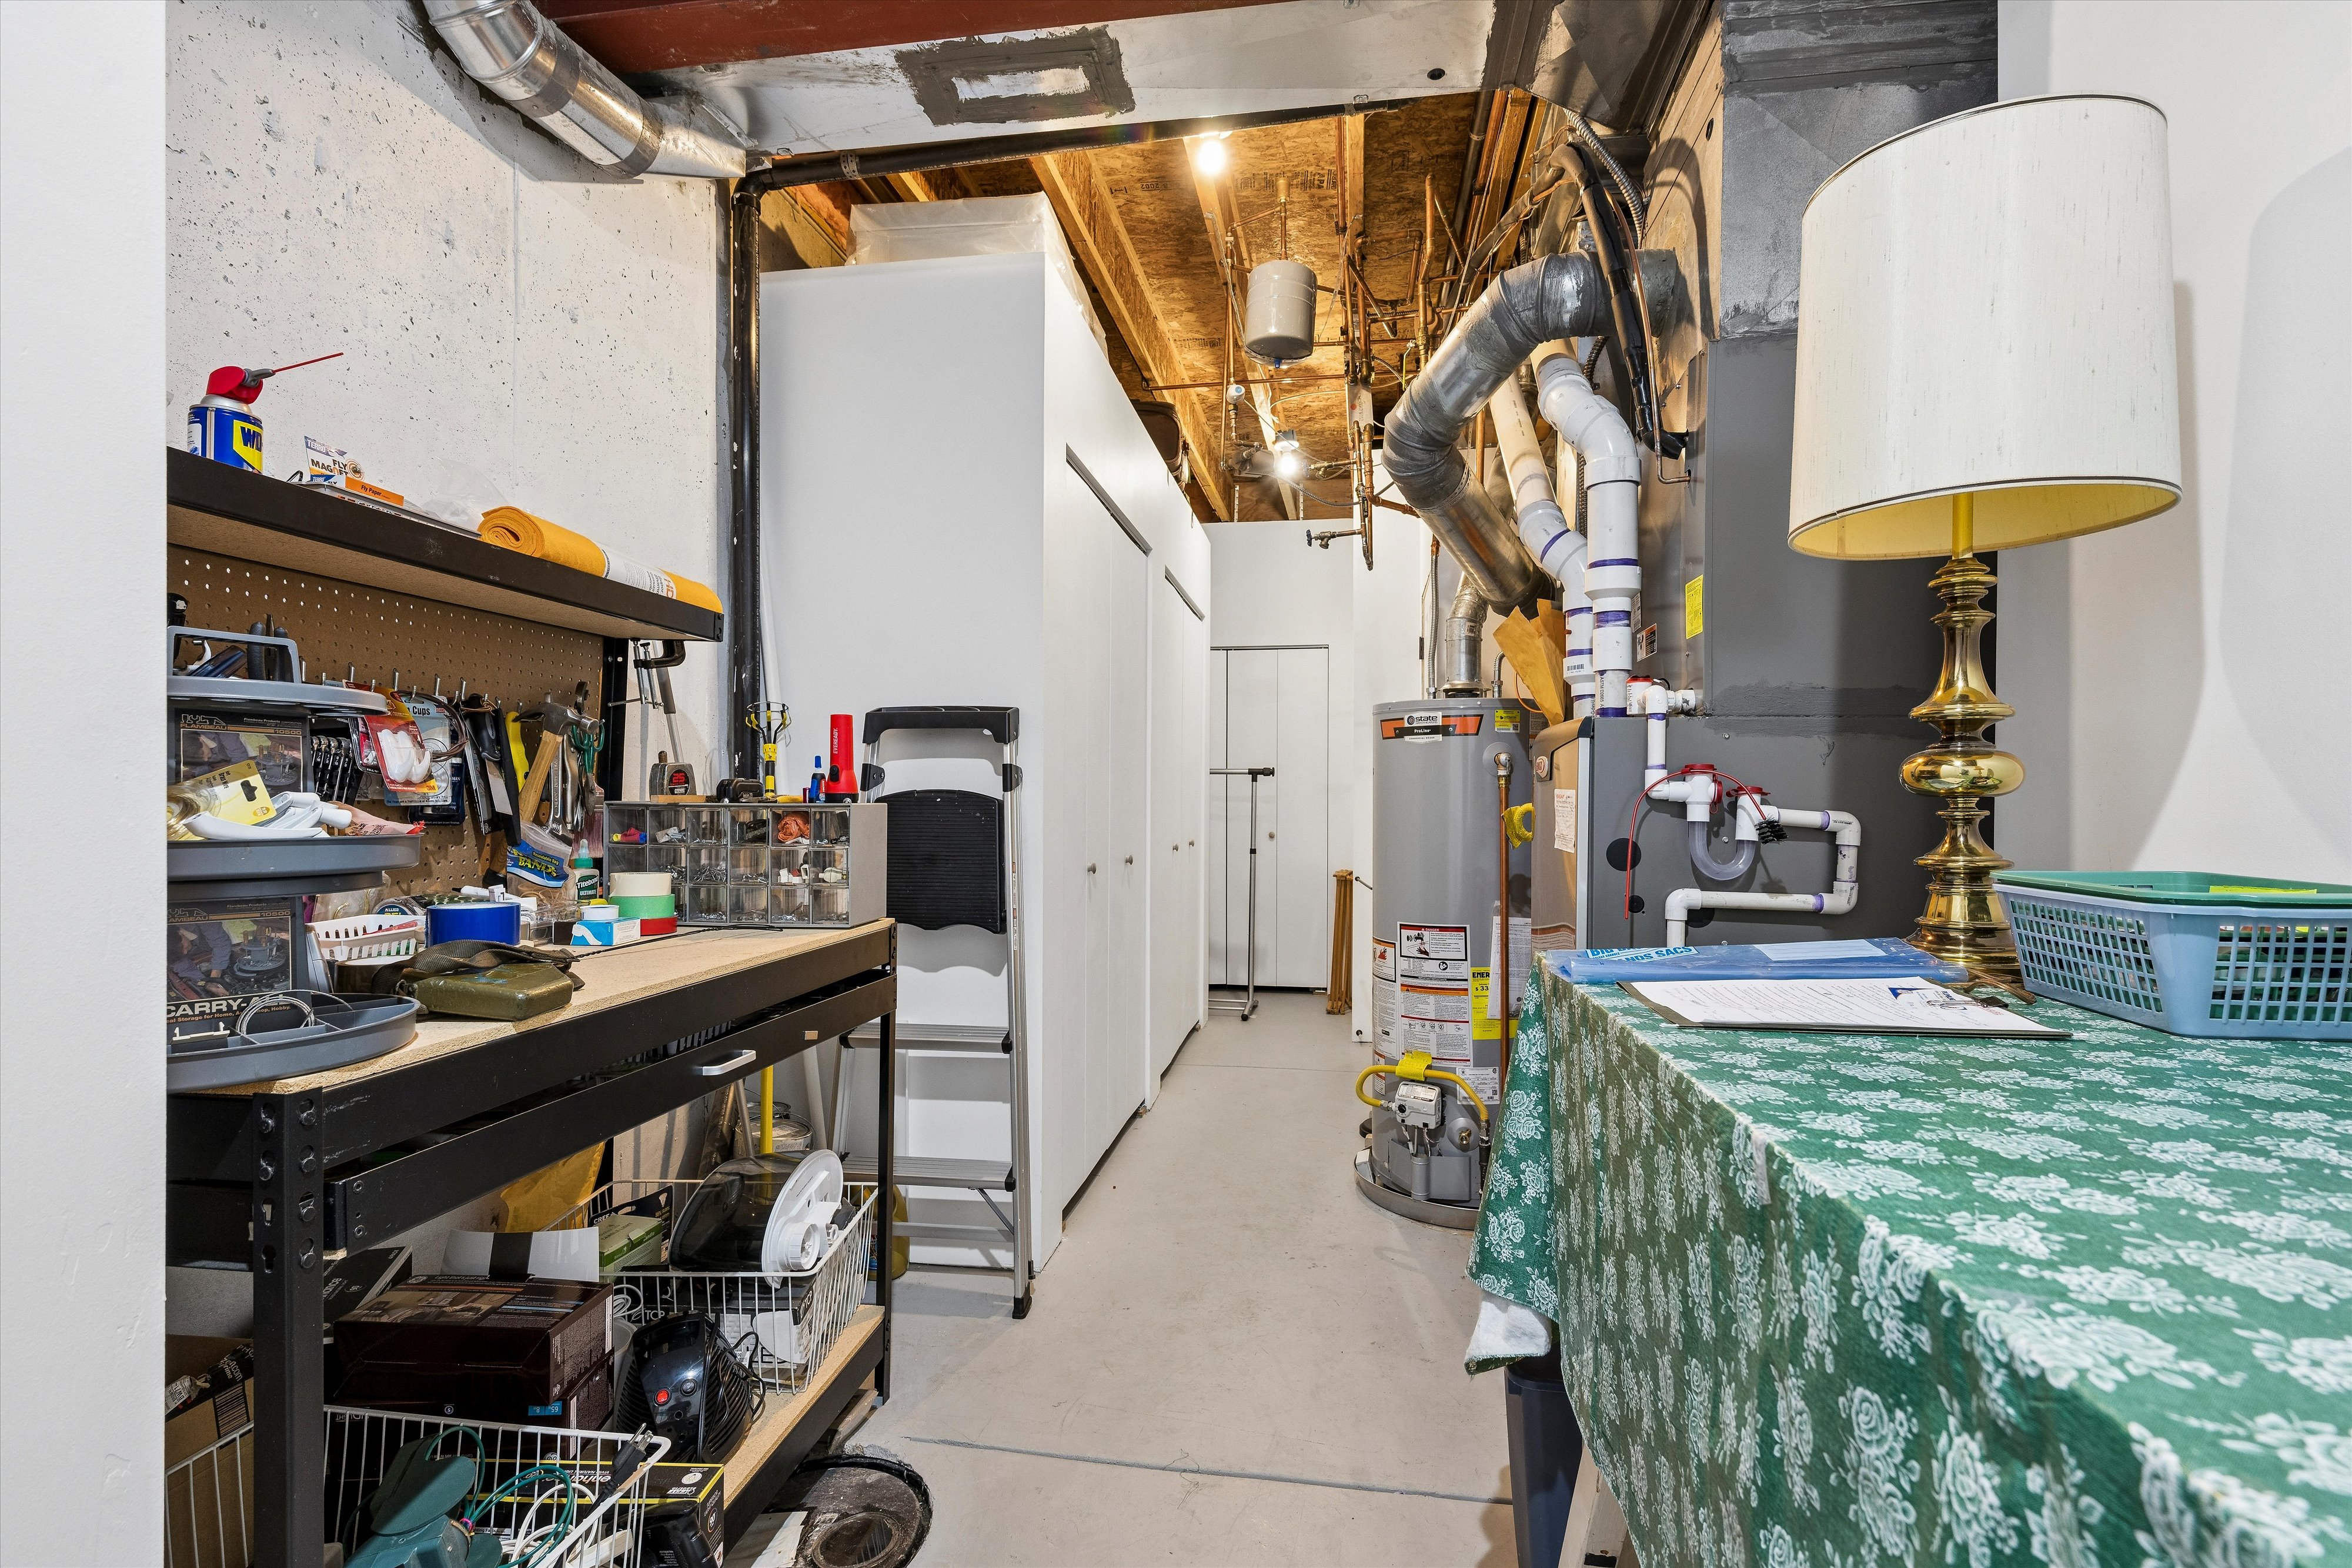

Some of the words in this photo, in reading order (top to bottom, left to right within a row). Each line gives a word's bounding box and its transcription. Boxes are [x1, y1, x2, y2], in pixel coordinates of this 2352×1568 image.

[307, 439, 326, 453] TERRO
[332, 459, 348, 470] FLY
[369, 487, 382, 497] Paper
[412, 706, 430, 716] Cups
[672, 773, 686, 783] 25
[533, 851, 552, 863] Resealable
[518, 856, 557, 877] BANDS
[576, 874, 599, 890] Titebond
[1654, 946, 1692, 958] SACS
[803, 1291, 813, 1310] TCP
[645, 1309, 666, 1320] TCP
